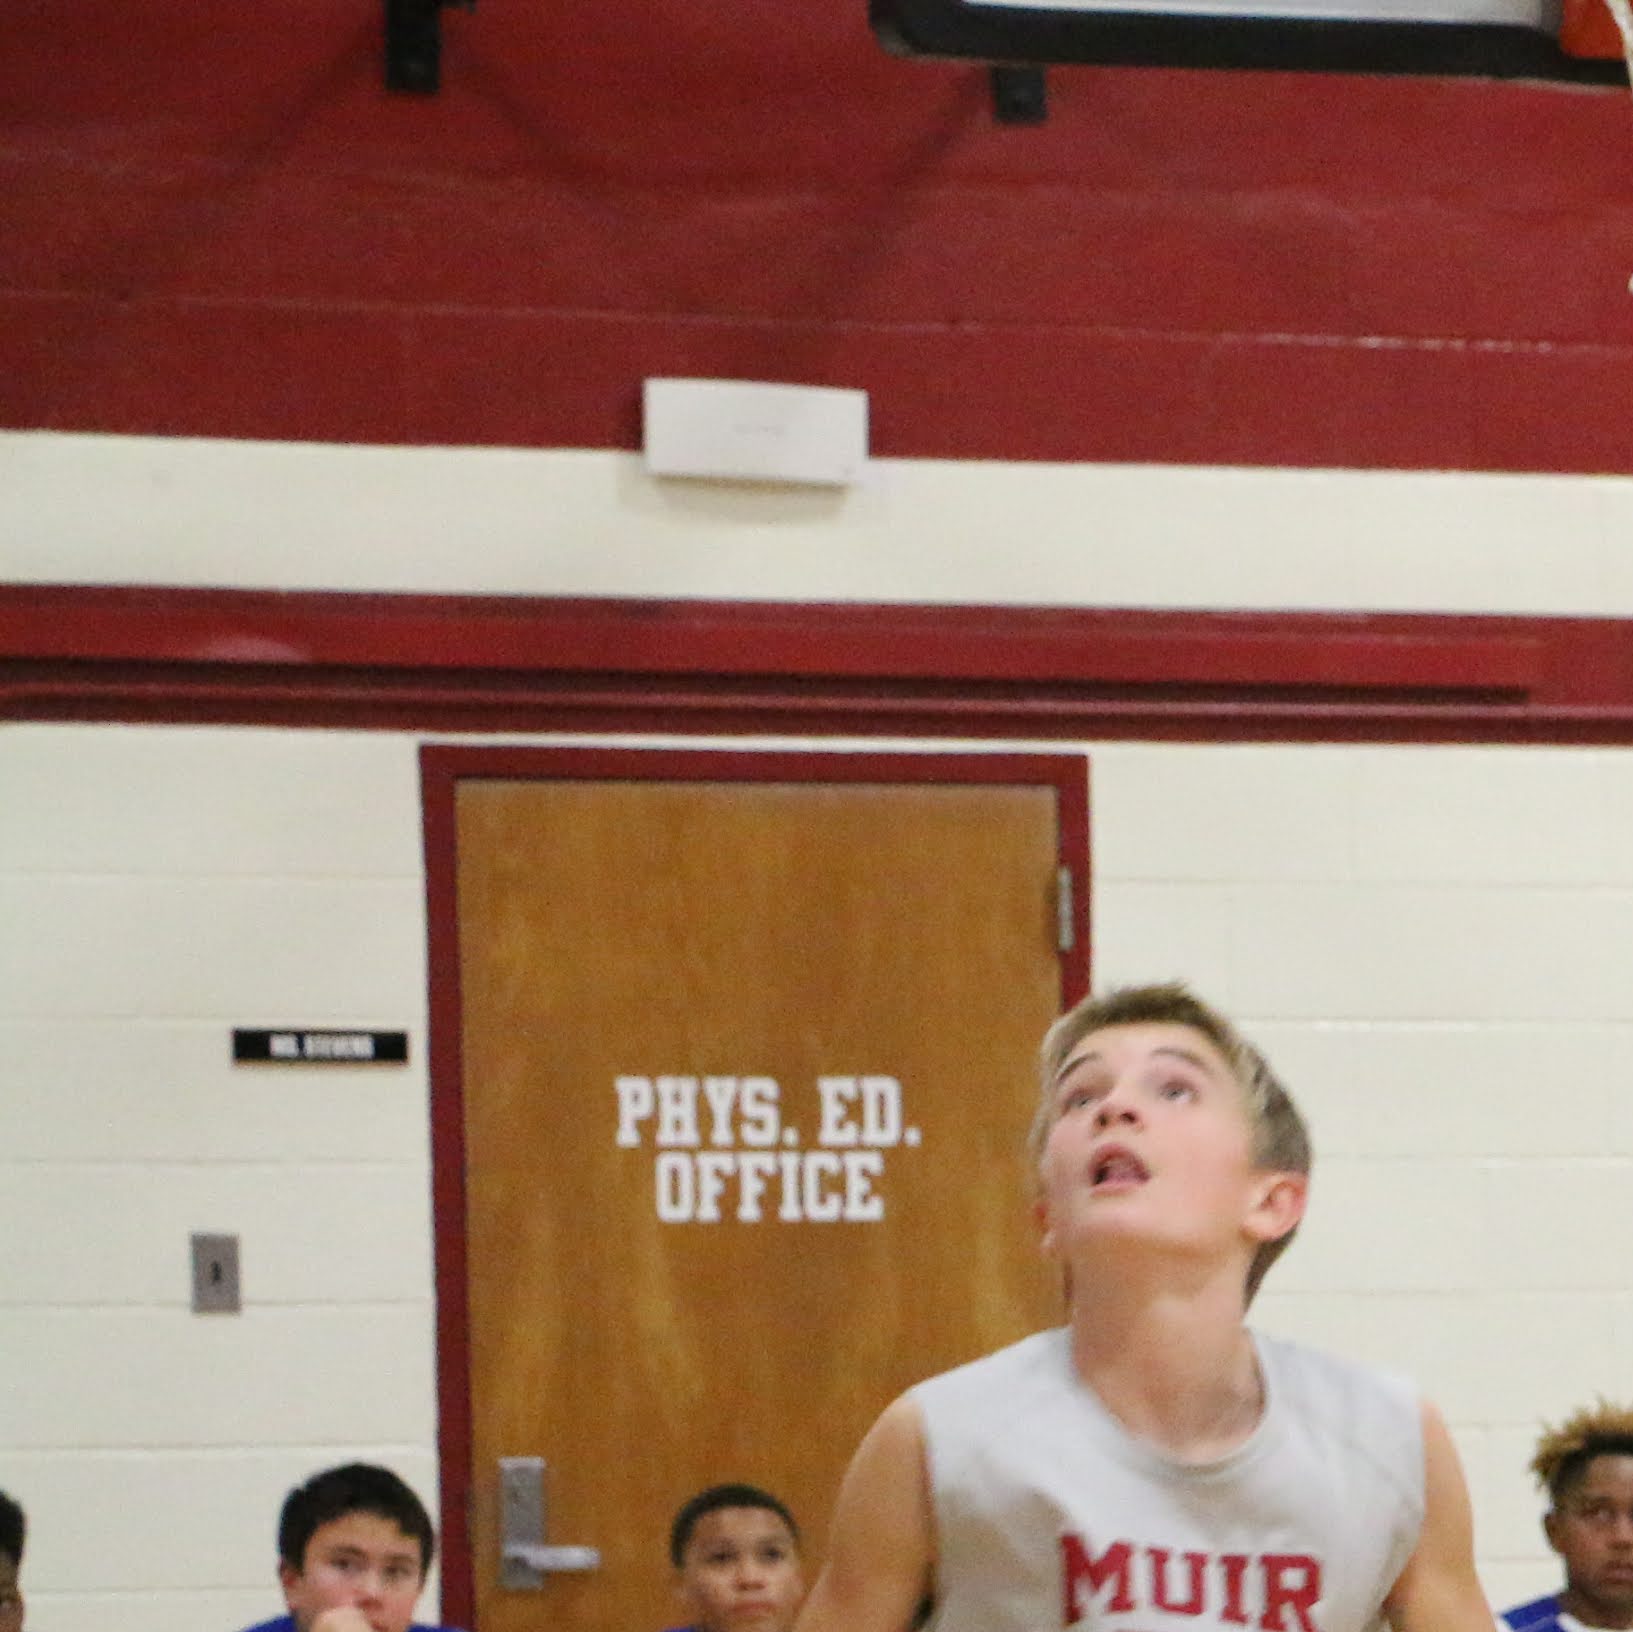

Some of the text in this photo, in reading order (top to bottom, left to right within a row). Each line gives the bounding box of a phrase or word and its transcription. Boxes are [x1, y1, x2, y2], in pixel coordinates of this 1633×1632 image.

[614, 1075, 922, 1148] PHYS. ED.
[655, 1151, 885, 1222] OFFICE
